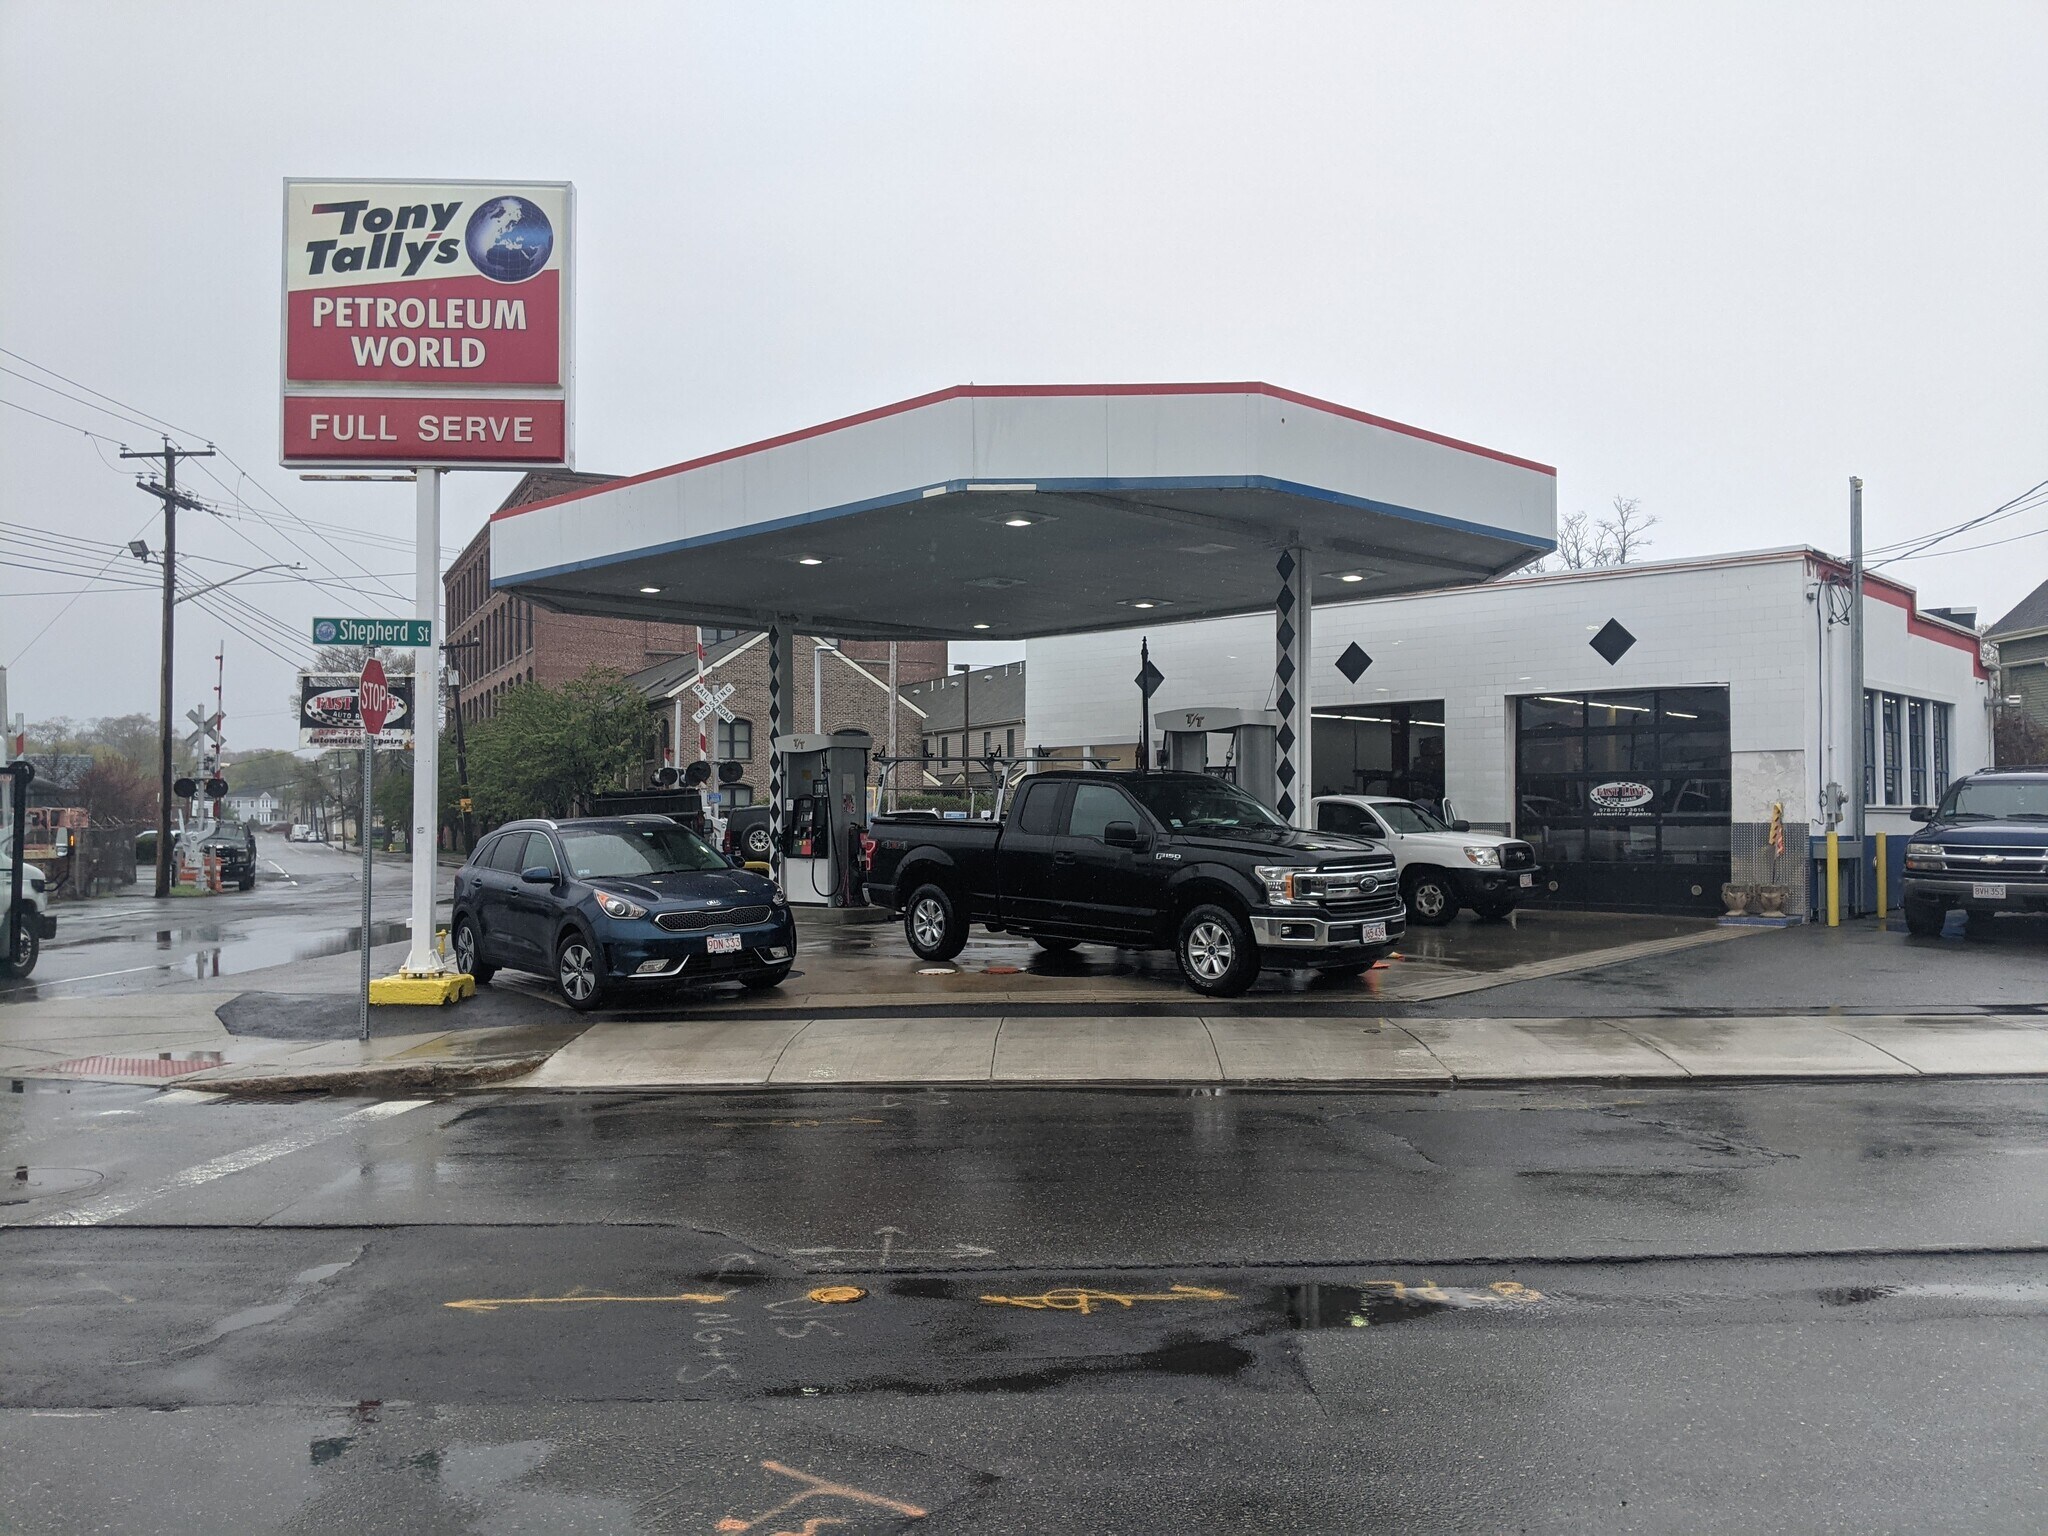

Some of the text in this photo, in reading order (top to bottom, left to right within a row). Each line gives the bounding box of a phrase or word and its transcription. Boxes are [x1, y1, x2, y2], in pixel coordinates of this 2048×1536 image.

[312, 200, 463, 235] Tony
[306, 232, 460, 277] Tally's
[312, 297, 527, 330] PETROLEUM
[350, 336, 486, 368] WORLD
[310, 414, 533, 442] FULL SERVE
[339, 620, 408, 644] Shepherd
[417, 626, 429, 642] St
[316, 697, 353, 710] FAST
[362, 681, 386, 711] STOP
[694, 684, 734, 721] RAIL ROAD
[695, 686, 732, 719] CROSSING
[333, 711, 351, 719] AUTO
[307, 736, 362, 744] Automotive
[708, 938, 740, 950] 9DN 333
